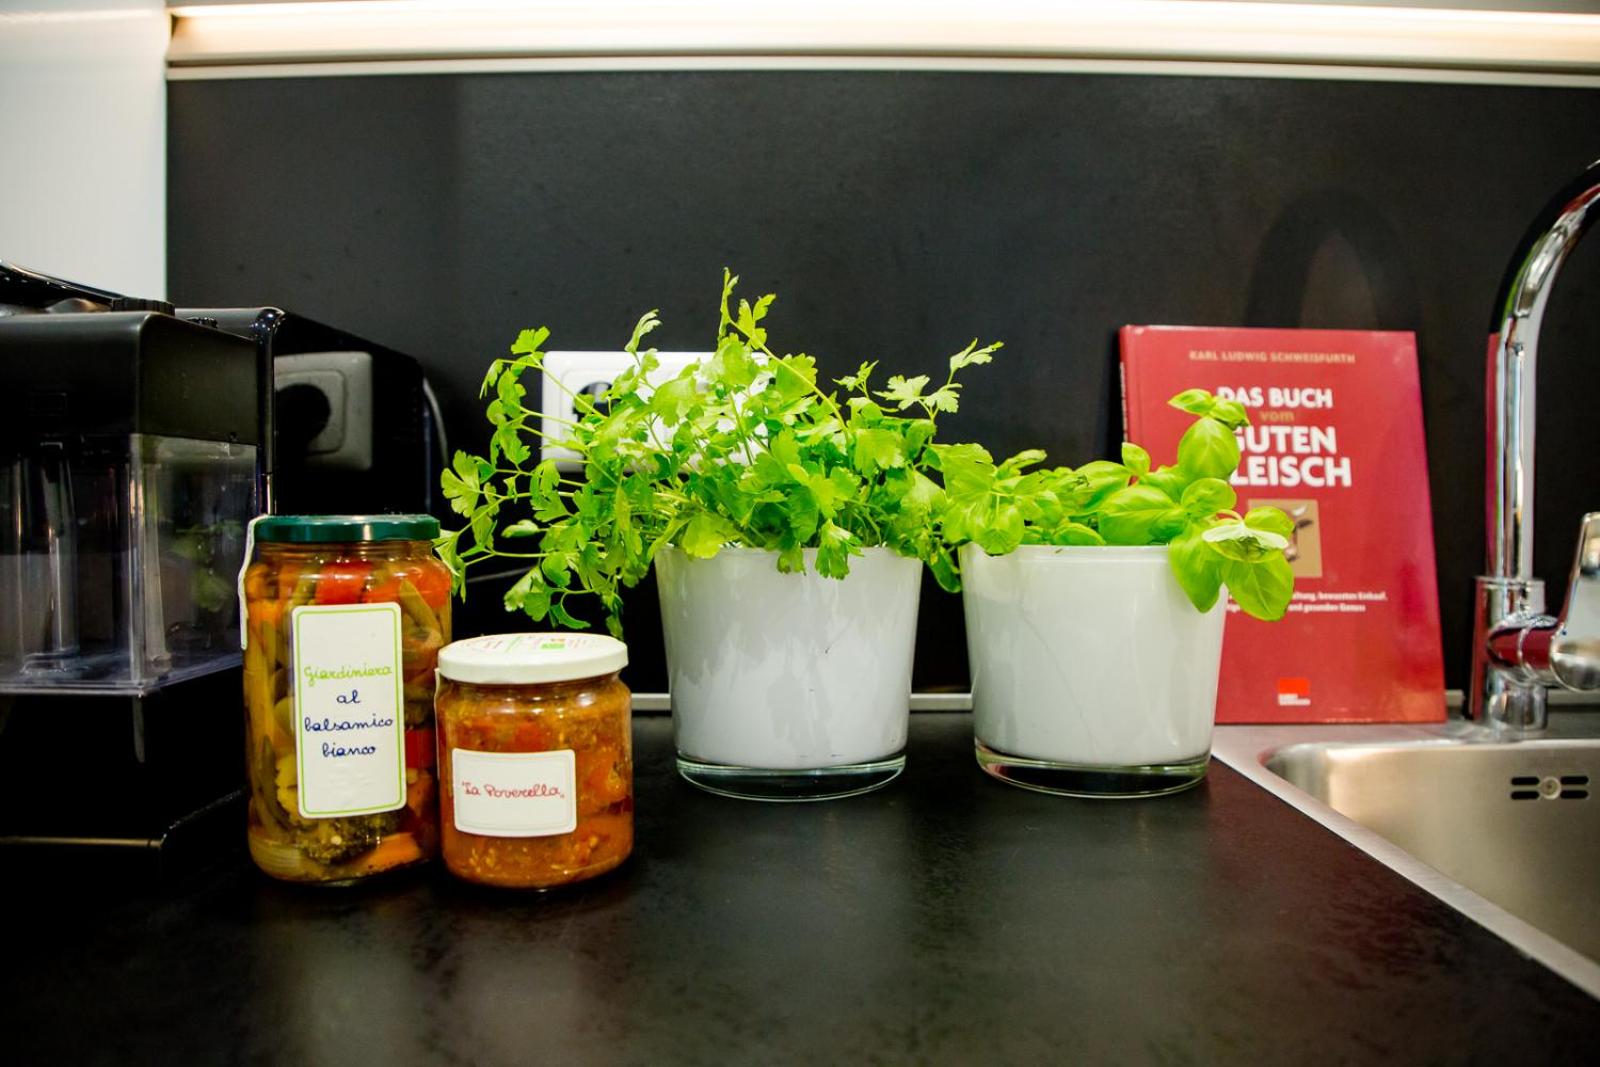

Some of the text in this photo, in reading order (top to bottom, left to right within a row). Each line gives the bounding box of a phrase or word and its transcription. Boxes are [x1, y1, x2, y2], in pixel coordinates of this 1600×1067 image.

[1189, 350, 1217, 361] KARL
[1222, 351, 1267, 362] LUDWIG
[1216, 386, 1334, 408] DAS BUCH
[1259, 411, 1295, 422] vom
[1229, 456, 1352, 487] LEISCH
[336, 689, 361, 704] al
[304, 713, 394, 732] balsamico
[322, 742, 377, 758] bianco
